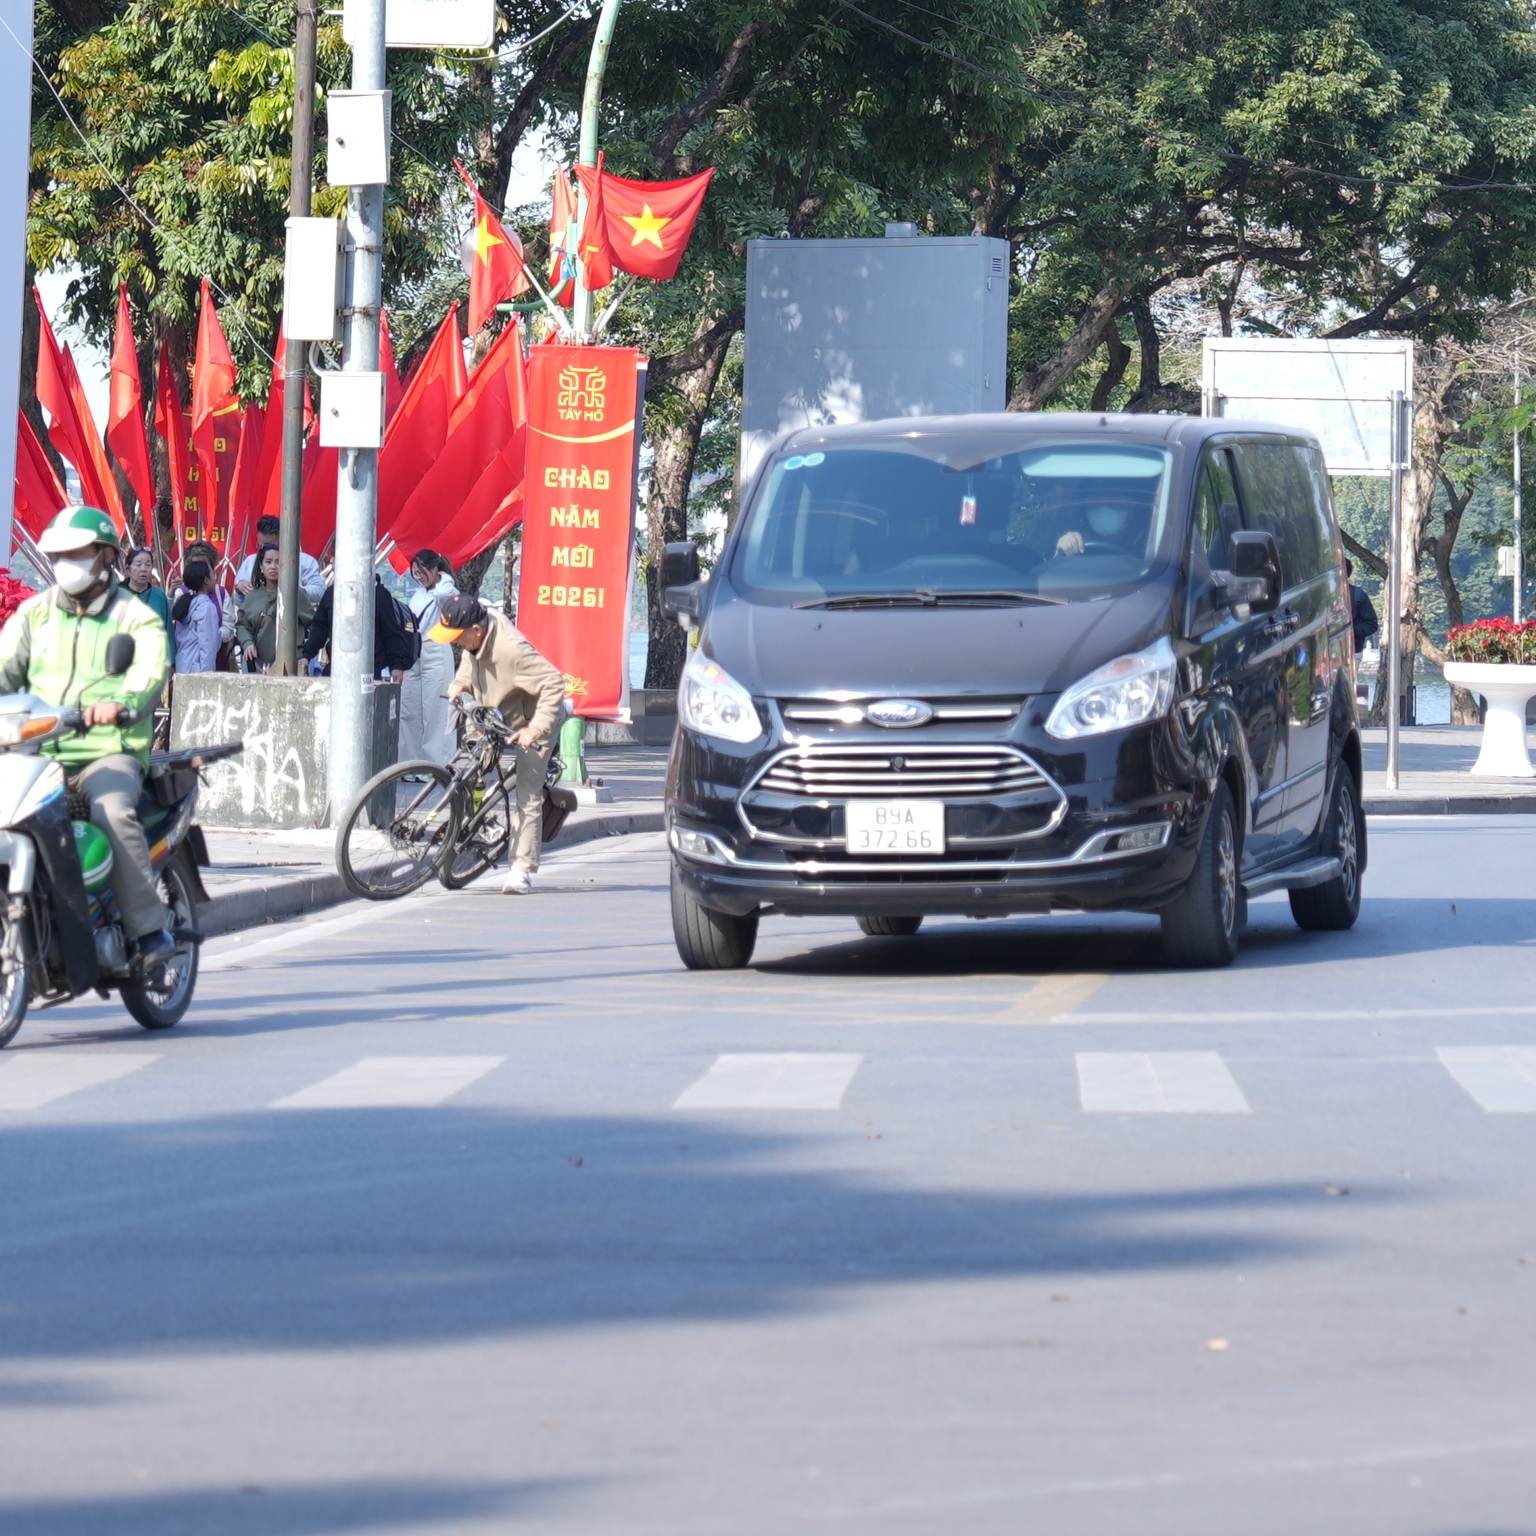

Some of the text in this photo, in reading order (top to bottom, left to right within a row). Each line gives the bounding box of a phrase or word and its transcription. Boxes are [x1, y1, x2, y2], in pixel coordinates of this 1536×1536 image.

[558, 407, 582, 421] TÂY
[544, 464, 610, 490] CHÀO
[549, 503, 600, 530] NĂM
[551, 543, 594, 569] MỚI
[537, 585, 605, 608] 2026!
[876, 807, 913, 825] 89A
[859, 830, 931, 849] 372.66
